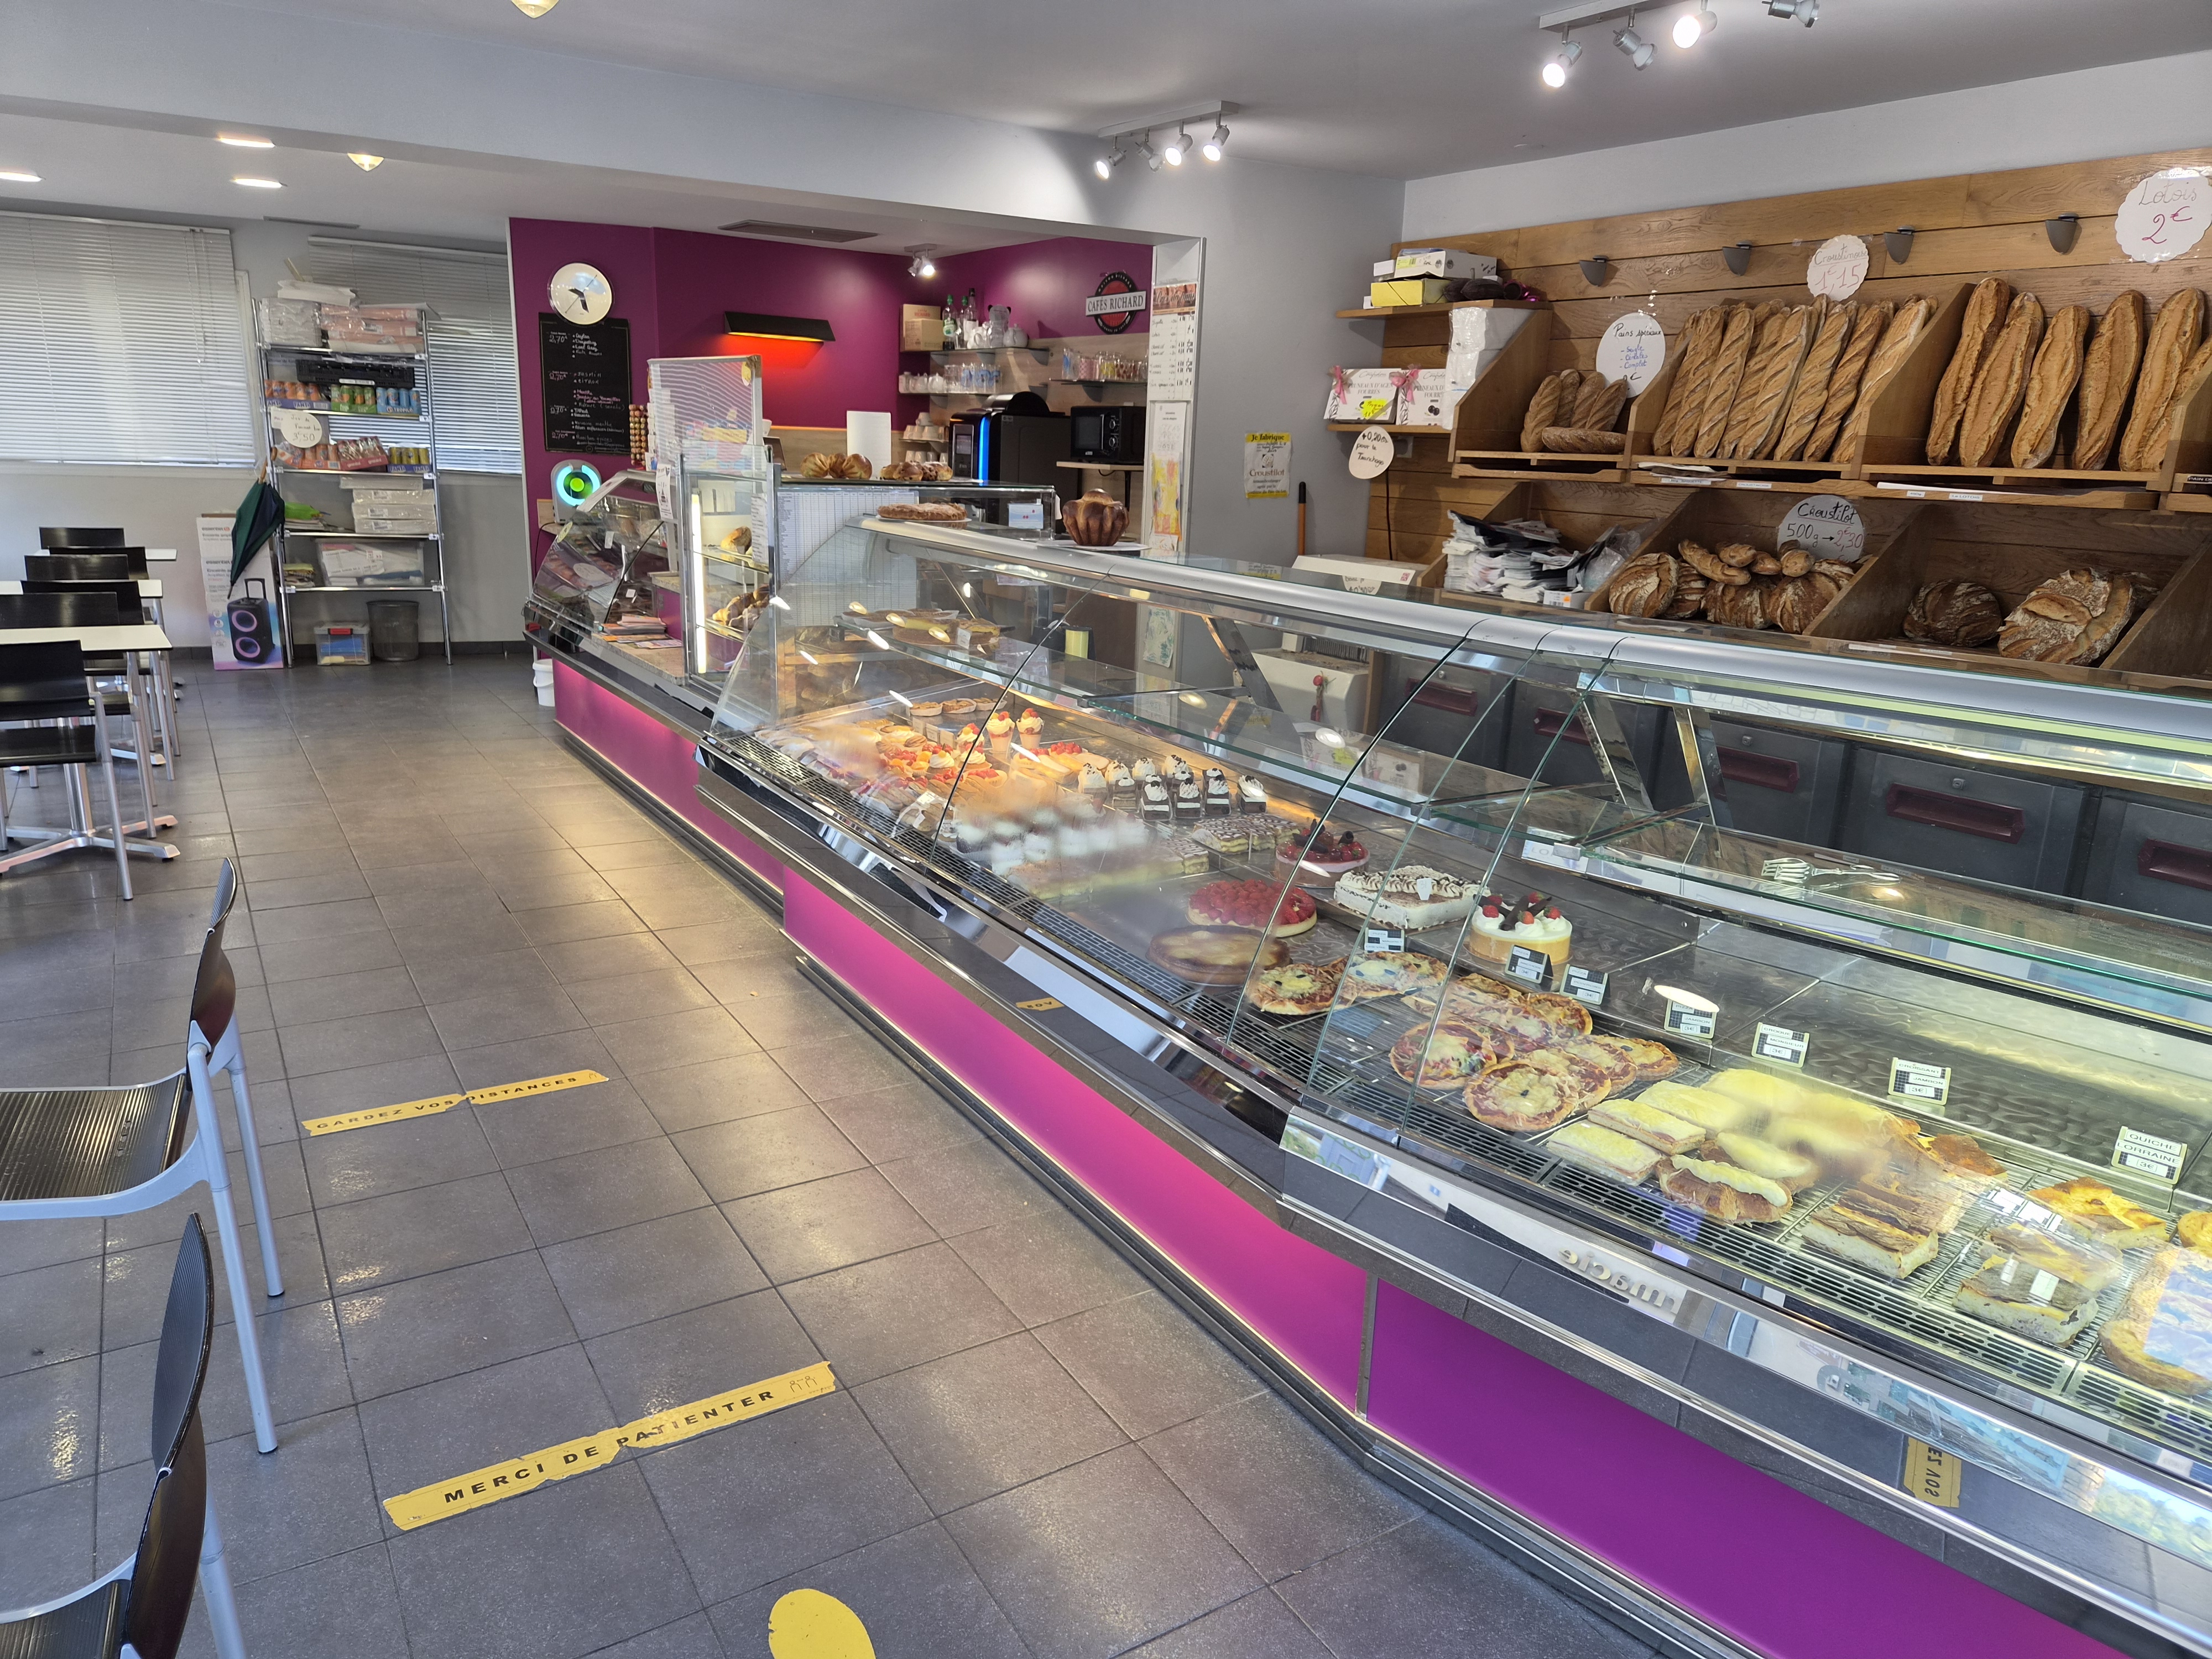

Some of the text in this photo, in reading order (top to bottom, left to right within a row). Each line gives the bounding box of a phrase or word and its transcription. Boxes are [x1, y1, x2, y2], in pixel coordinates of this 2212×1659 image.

[2138, 180, 2197, 205] Lotois
[1088, 295, 1144, 312] CAFÉS RICHARD
[1614, 323, 1633, 337] Pains
[1624, 359, 1647, 371] Complet
[1798, 502, 1858, 524] Croustilot
[1764, 1027, 1791, 1036] CROQUE
[1770, 1038, 1804, 1048] MONSIEUR
[1899, 1063, 1939, 1073] CROISSANT
[317, 1077, 577, 1128] GARDEZ VOS DISTANCES
[2130, 1134, 2177, 1150] QUICHE
[2117, 1142, 2180, 1164] LORRAINE
[2140, 1161, 2154, 1170] 3€
[445, 1391, 774, 1503] MERCI DE PATIENTER
